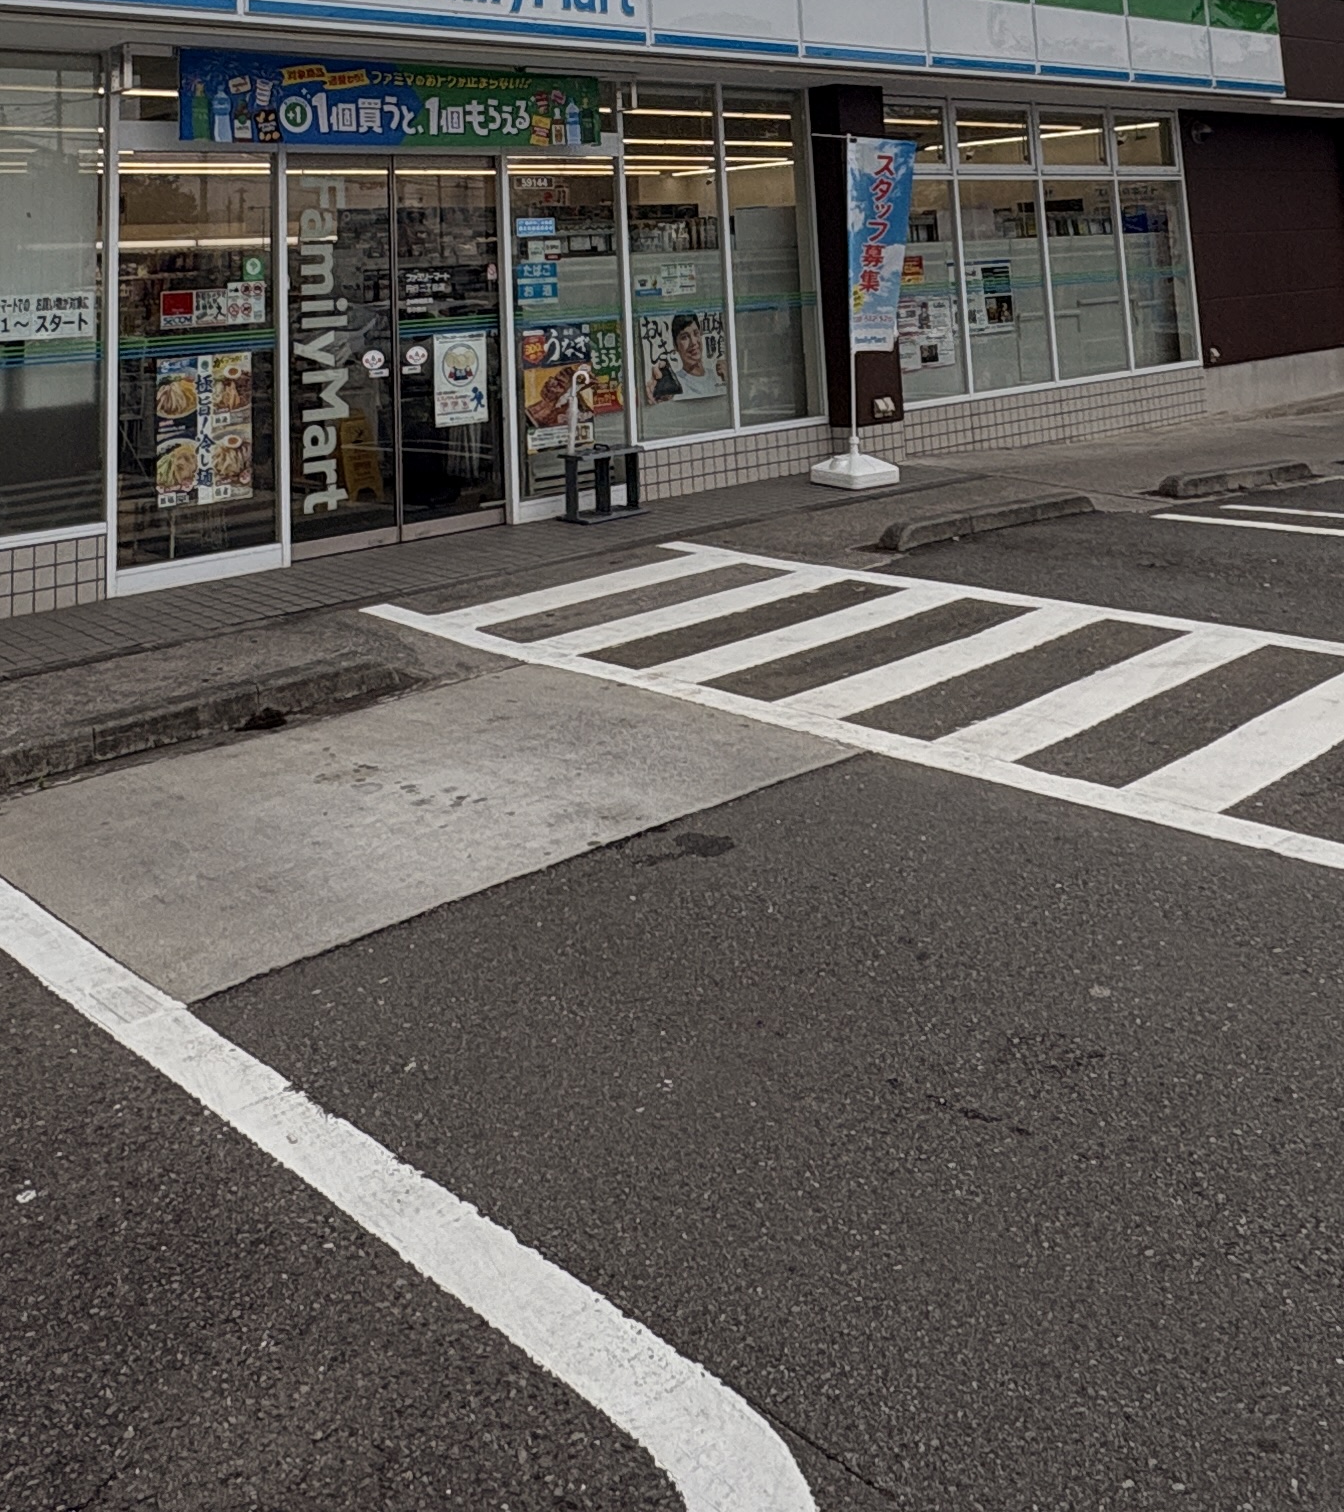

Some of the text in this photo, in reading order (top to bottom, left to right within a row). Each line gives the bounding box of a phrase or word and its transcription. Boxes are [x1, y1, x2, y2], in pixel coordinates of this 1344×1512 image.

[312, 91, 531, 137] 1個買うと、1個もらえる
[859, 155, 896, 293] スタッフ募集
[523, 265, 552, 277] たばこ
[293, 176, 350, 515] FamilyMart
[544, 328, 590, 364] うなぎ
